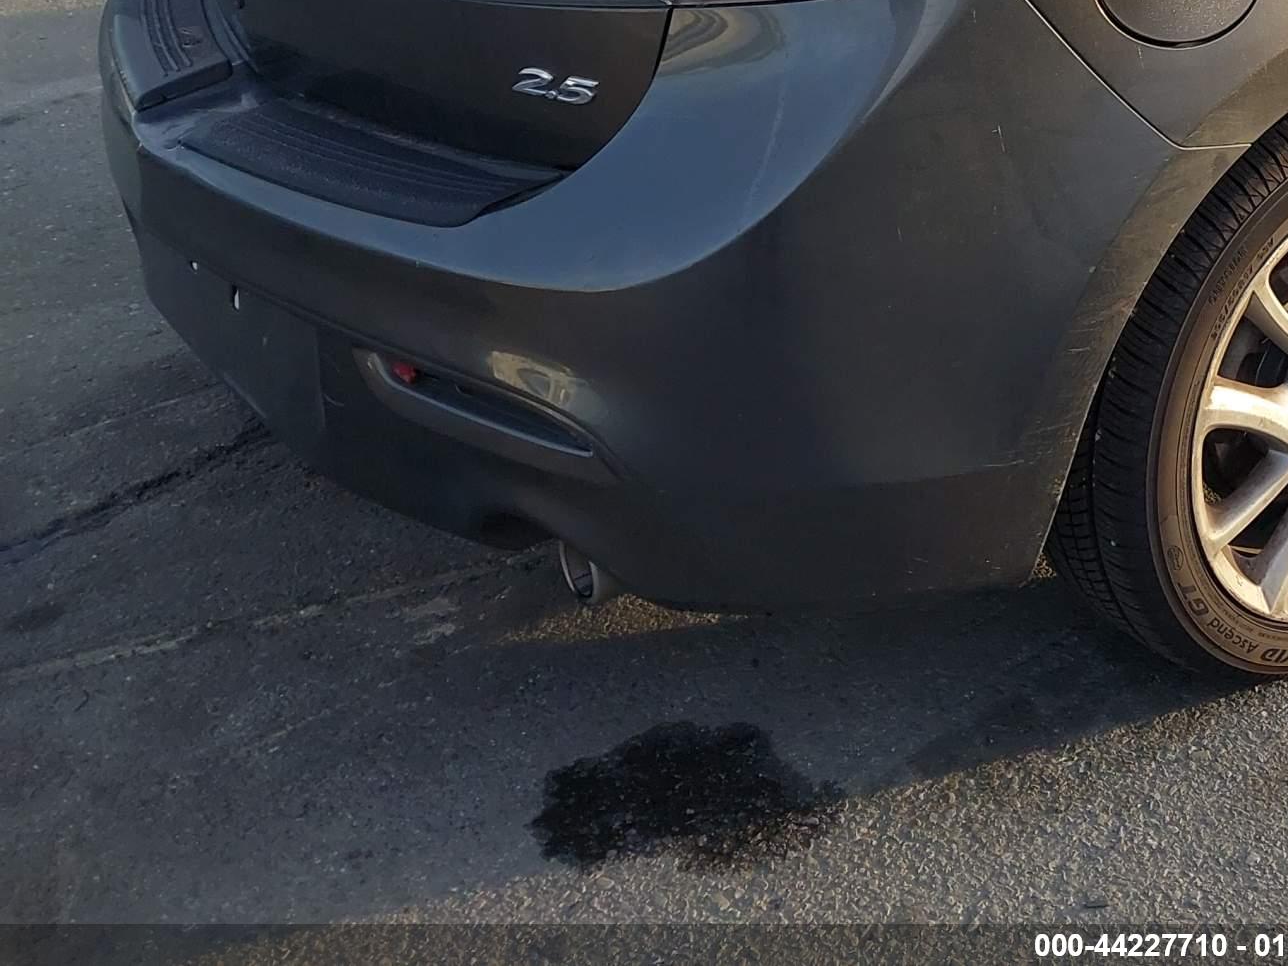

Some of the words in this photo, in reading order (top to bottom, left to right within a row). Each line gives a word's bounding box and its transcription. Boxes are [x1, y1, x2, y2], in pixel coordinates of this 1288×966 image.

[511, 67, 600, 105] 2.5
[1178, 582, 1210, 617] GT
[1207, 616, 1259, 654] Ascend
